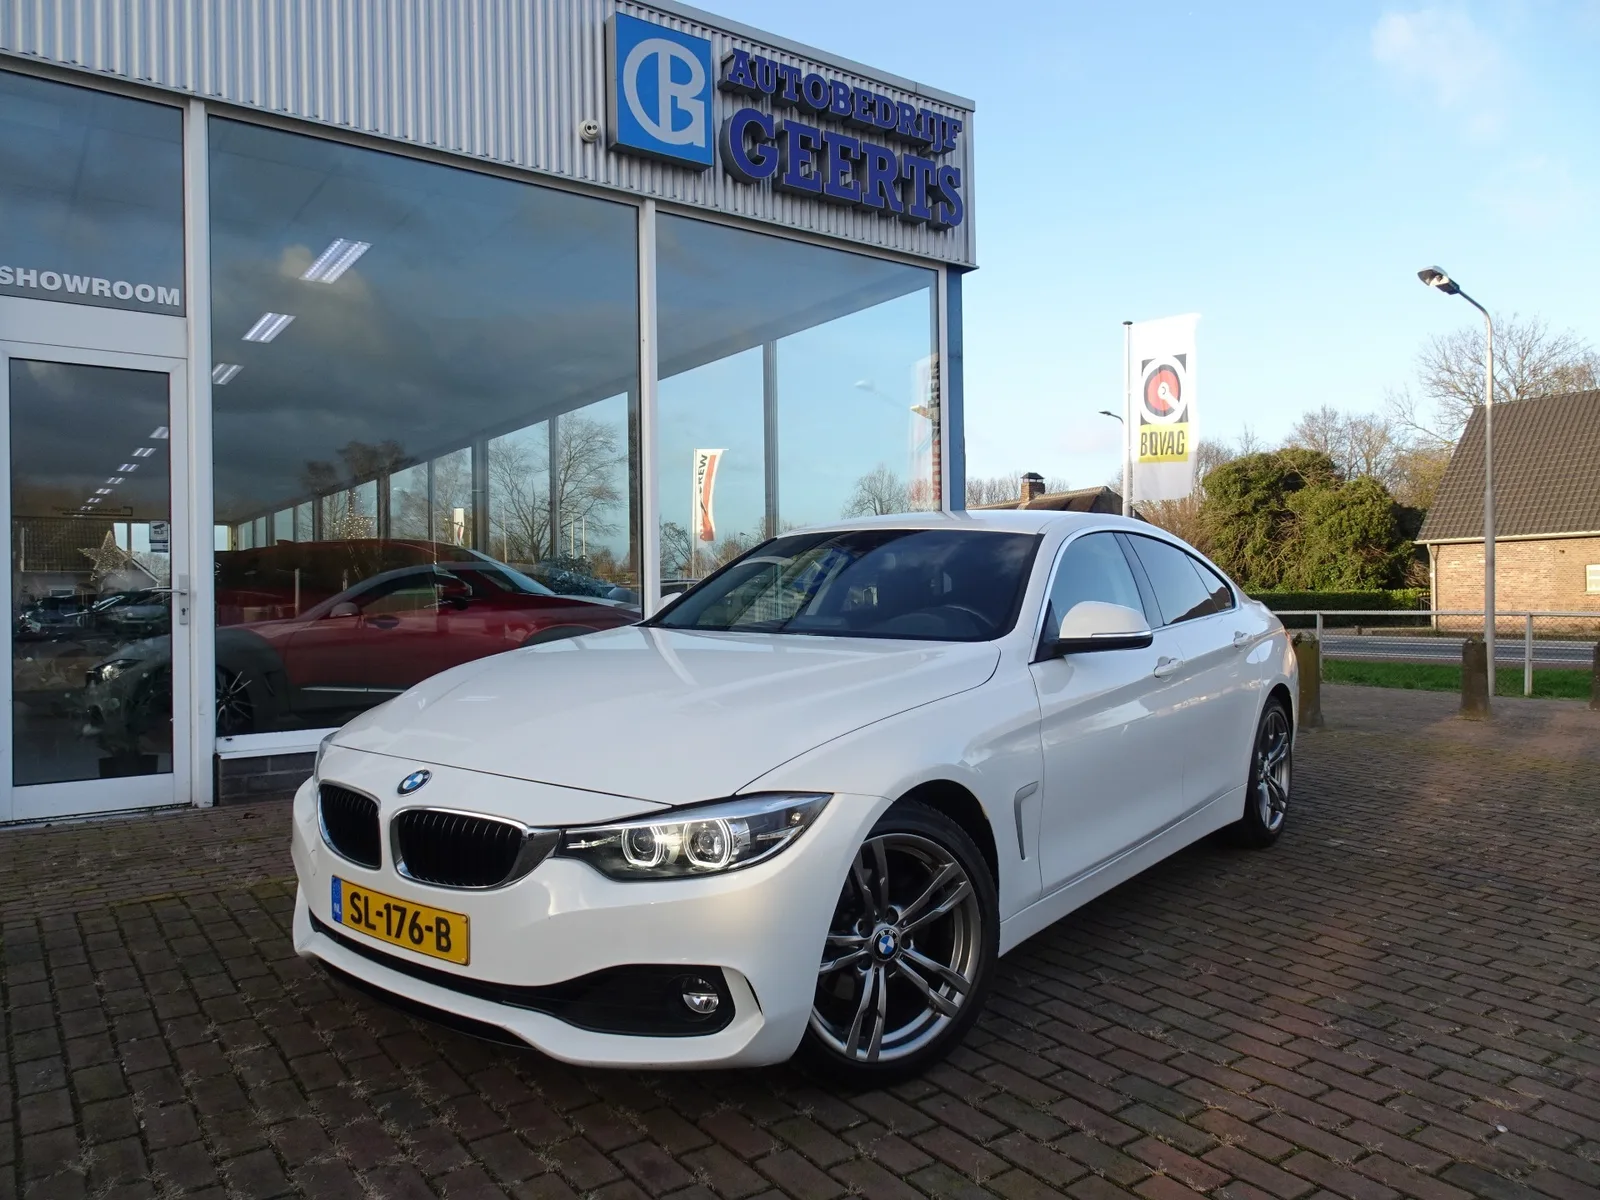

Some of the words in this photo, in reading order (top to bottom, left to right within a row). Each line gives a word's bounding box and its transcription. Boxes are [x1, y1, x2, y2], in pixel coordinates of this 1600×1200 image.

[727, 48, 963, 152] AUTOBEDRIJF
[735, 107, 963, 227] GEERTS
[0, 265, 180, 306] SHOWROOM
[1140, 430, 1186, 457] BOVAG
[350, 891, 452, 953] SL-176-B
